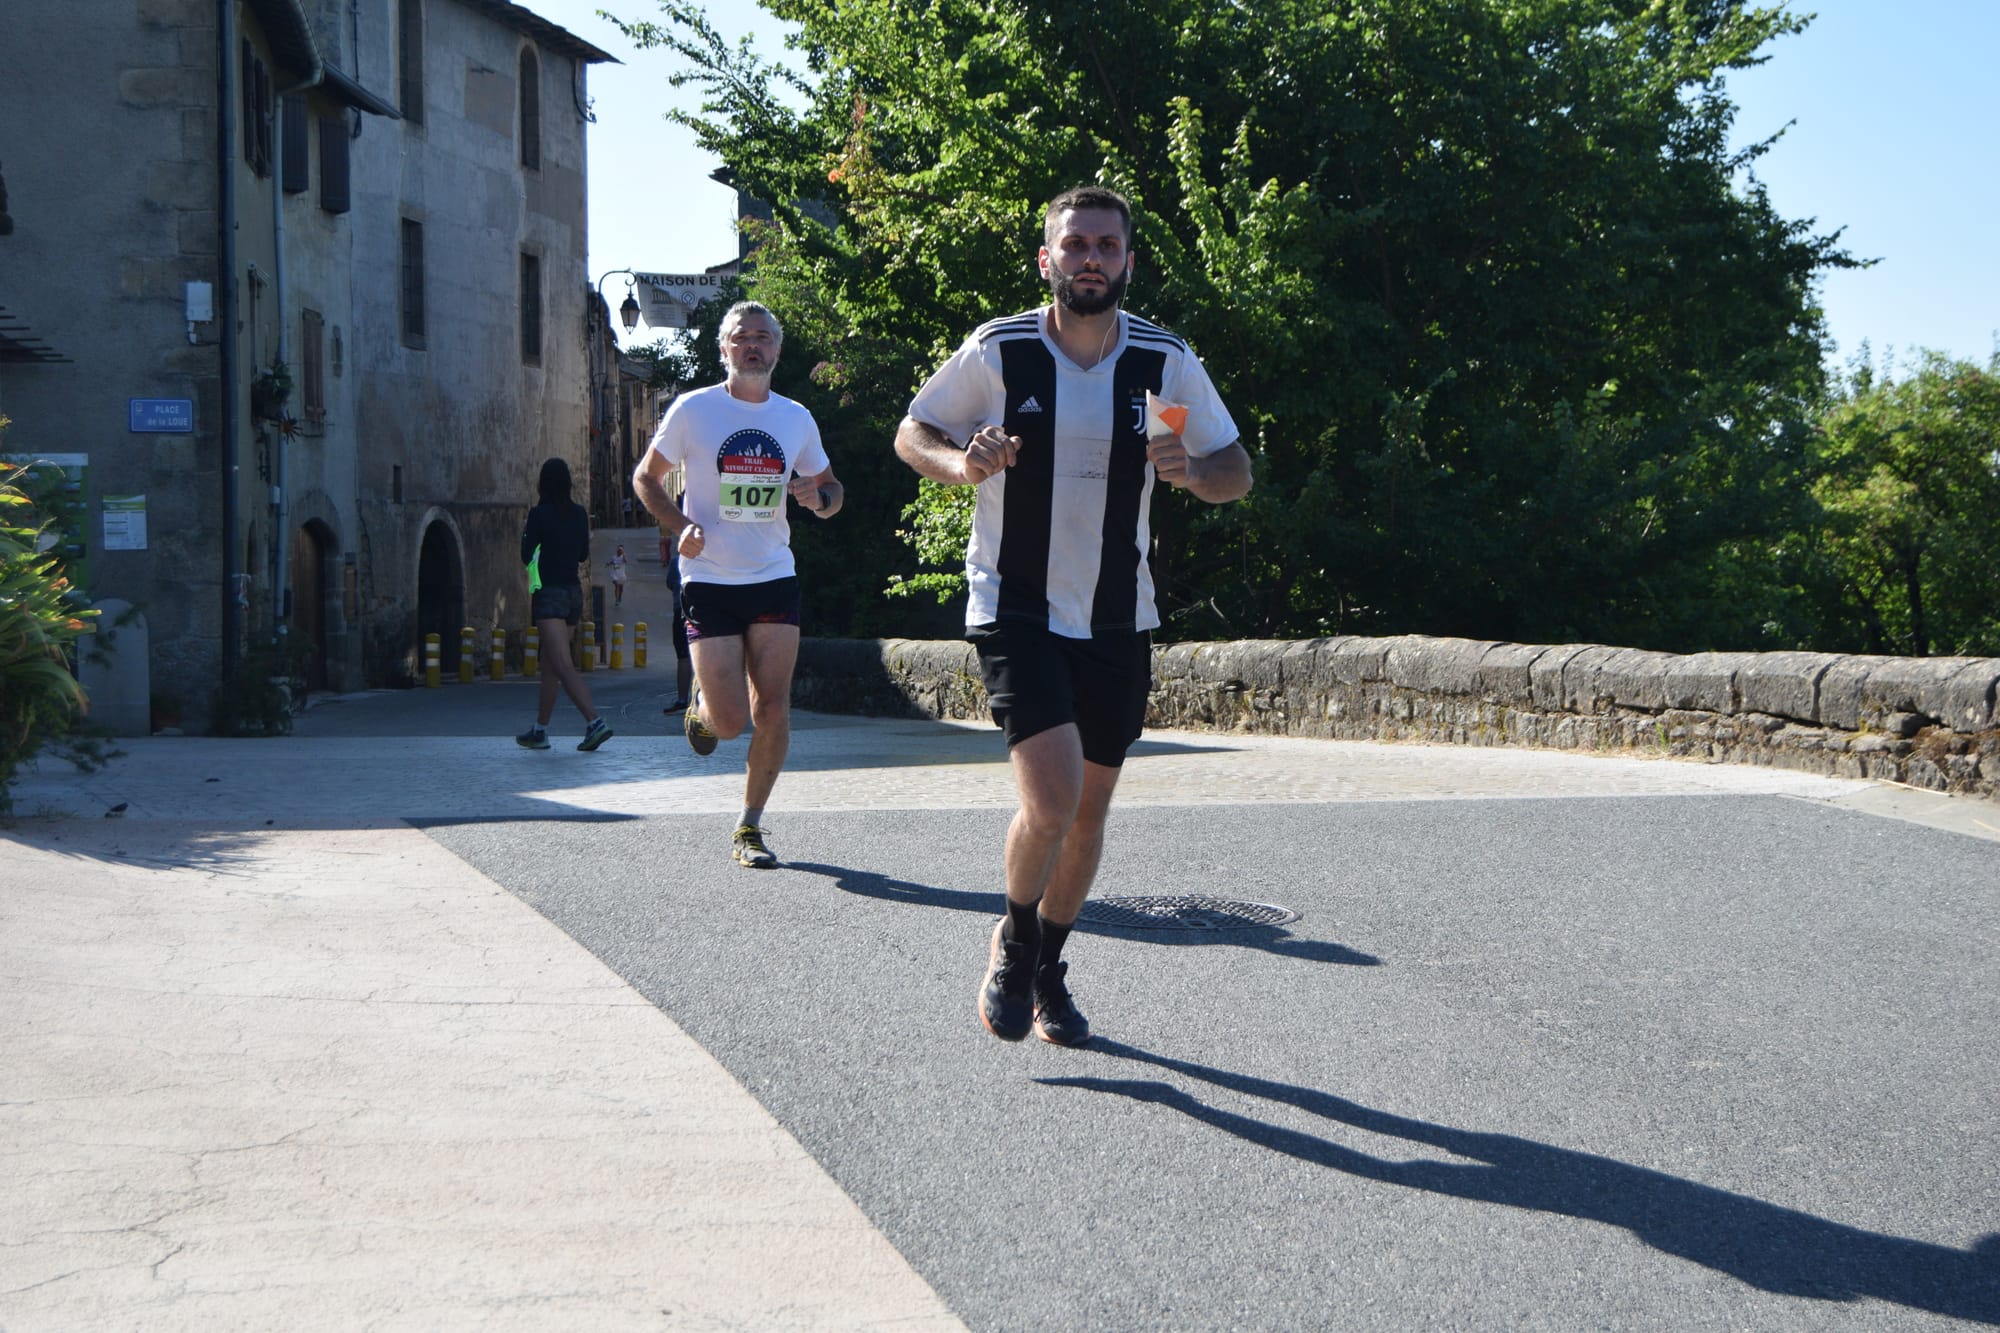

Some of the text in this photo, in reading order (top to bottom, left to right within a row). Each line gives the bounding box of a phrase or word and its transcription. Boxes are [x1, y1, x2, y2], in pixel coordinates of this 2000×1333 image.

[640, 275, 695, 286] MAISON
[699, 275, 717, 286] DE
[154, 405, 180, 414] PLACE
[730, 486, 776, 506] 107
